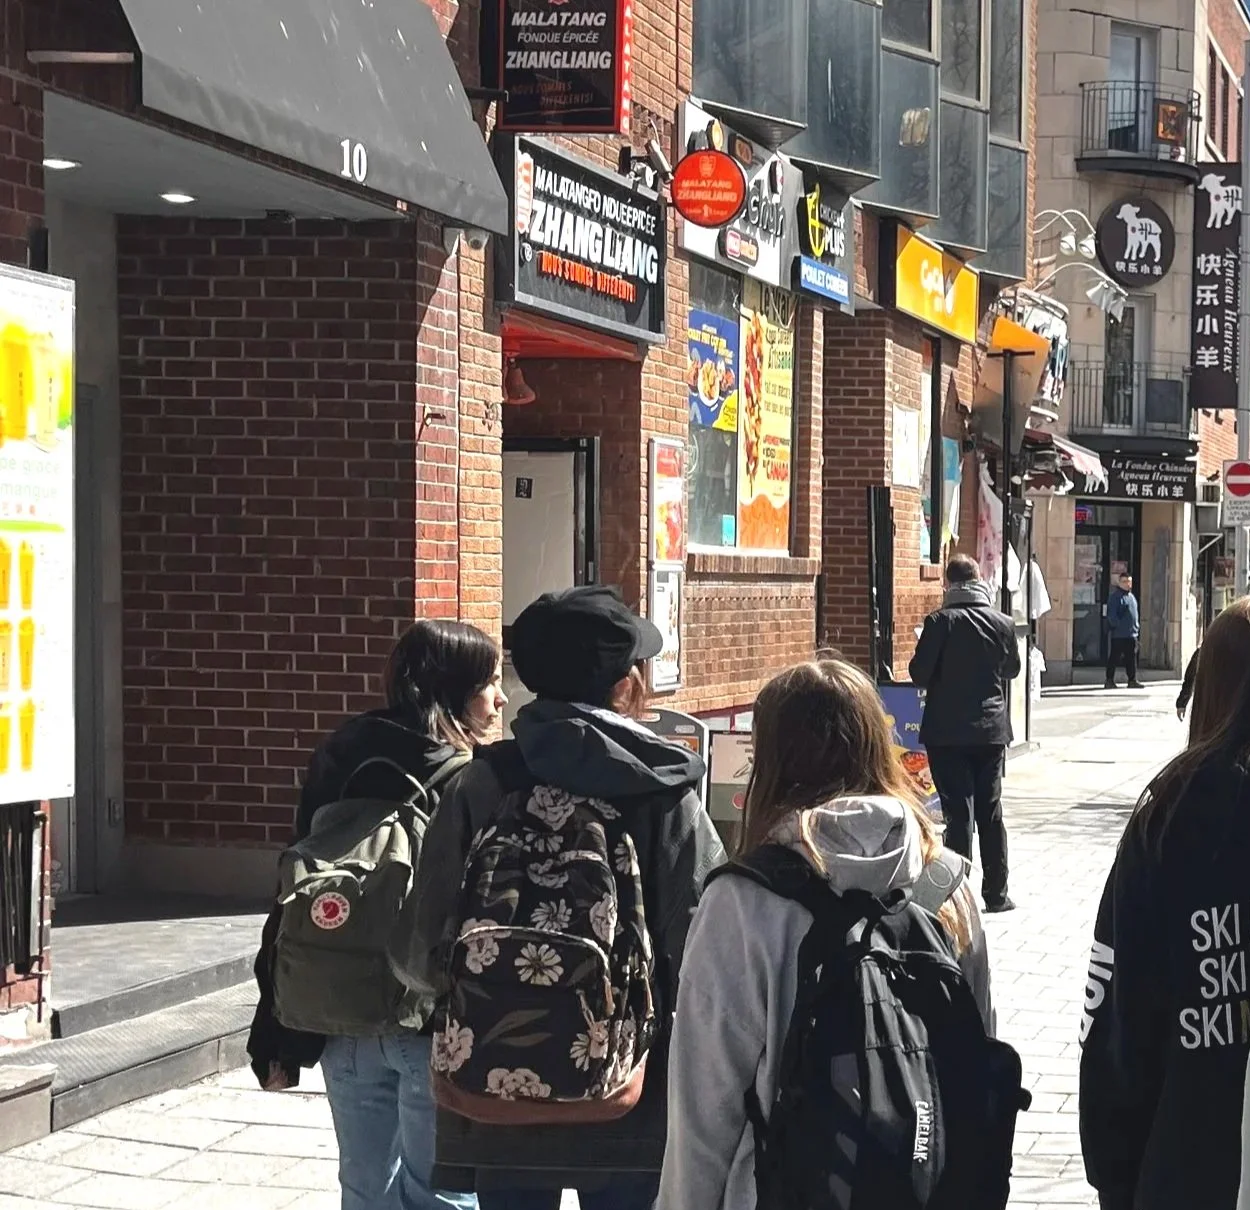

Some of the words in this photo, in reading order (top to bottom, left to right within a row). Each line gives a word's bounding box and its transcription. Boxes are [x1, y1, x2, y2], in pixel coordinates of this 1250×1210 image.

[511, 12, 607, 26] MALATANG
[517, 32, 561, 44] FONDUE
[562, 30, 600, 44] ÉPICÉE
[505, 51, 612, 69] ZHANGLIANG
[340, 138, 368, 183] 10
[676, 188, 738, 201] ZHANGLIANG
[681, 179, 733, 190] MALATANG
[529, 198, 659, 285] ZHANGLIANG
[824, 225, 846, 258] PLUS
[801, 261, 826, 290] POULET
[1114, 260, 1163, 276] 快乐小羊
[1222, 247, 1238, 305] Agneau
[1195, 253, 1222, 369] 快乐小羊
[1222, 308, 1238, 374] Heureux
[1111, 459, 1122, 470] La
[1125, 460, 1157, 471] Fondue
[1125, 483, 1184, 498] 快乐小羊
[1190, 903, 1241, 952] SKI
[1200, 951, 1247, 1000] SKI
[1179, 1002, 1234, 1050] SKI
